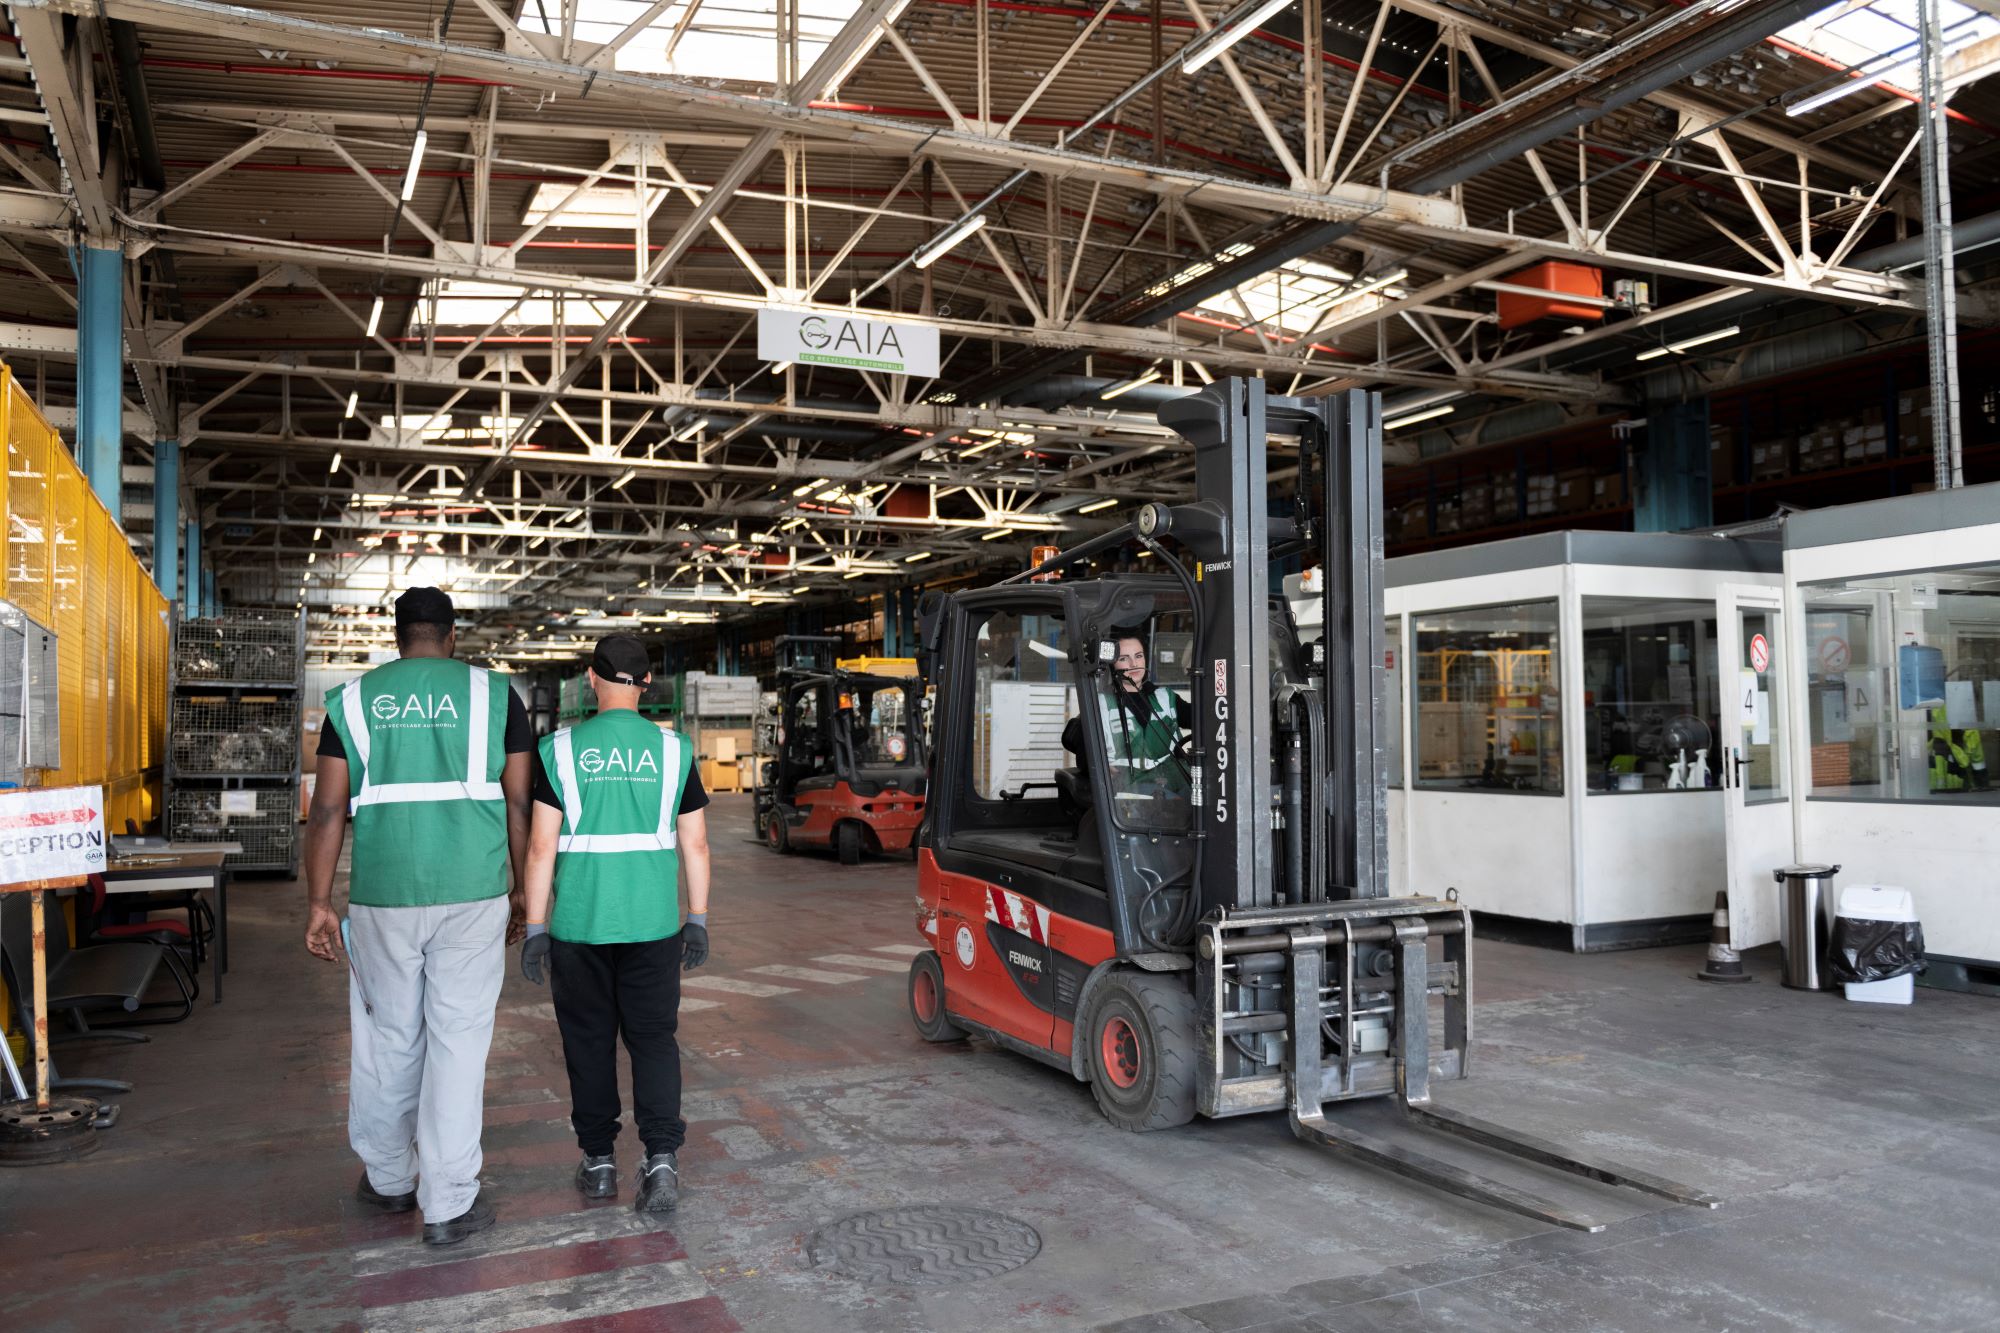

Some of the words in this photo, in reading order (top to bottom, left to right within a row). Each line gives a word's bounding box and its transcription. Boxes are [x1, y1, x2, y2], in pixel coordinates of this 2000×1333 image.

[799, 316, 904, 358] GAIA
[800, 353, 815, 361] ECO
[1205, 560, 1232, 573] FENWICK
[371, 694, 458, 720] GAIA
[1744, 689, 1753, 714] 4
[579, 747, 658, 774] GAIA
[1214, 696, 1229, 823] G4915
[1009, 950, 1042, 973] FENWICK
